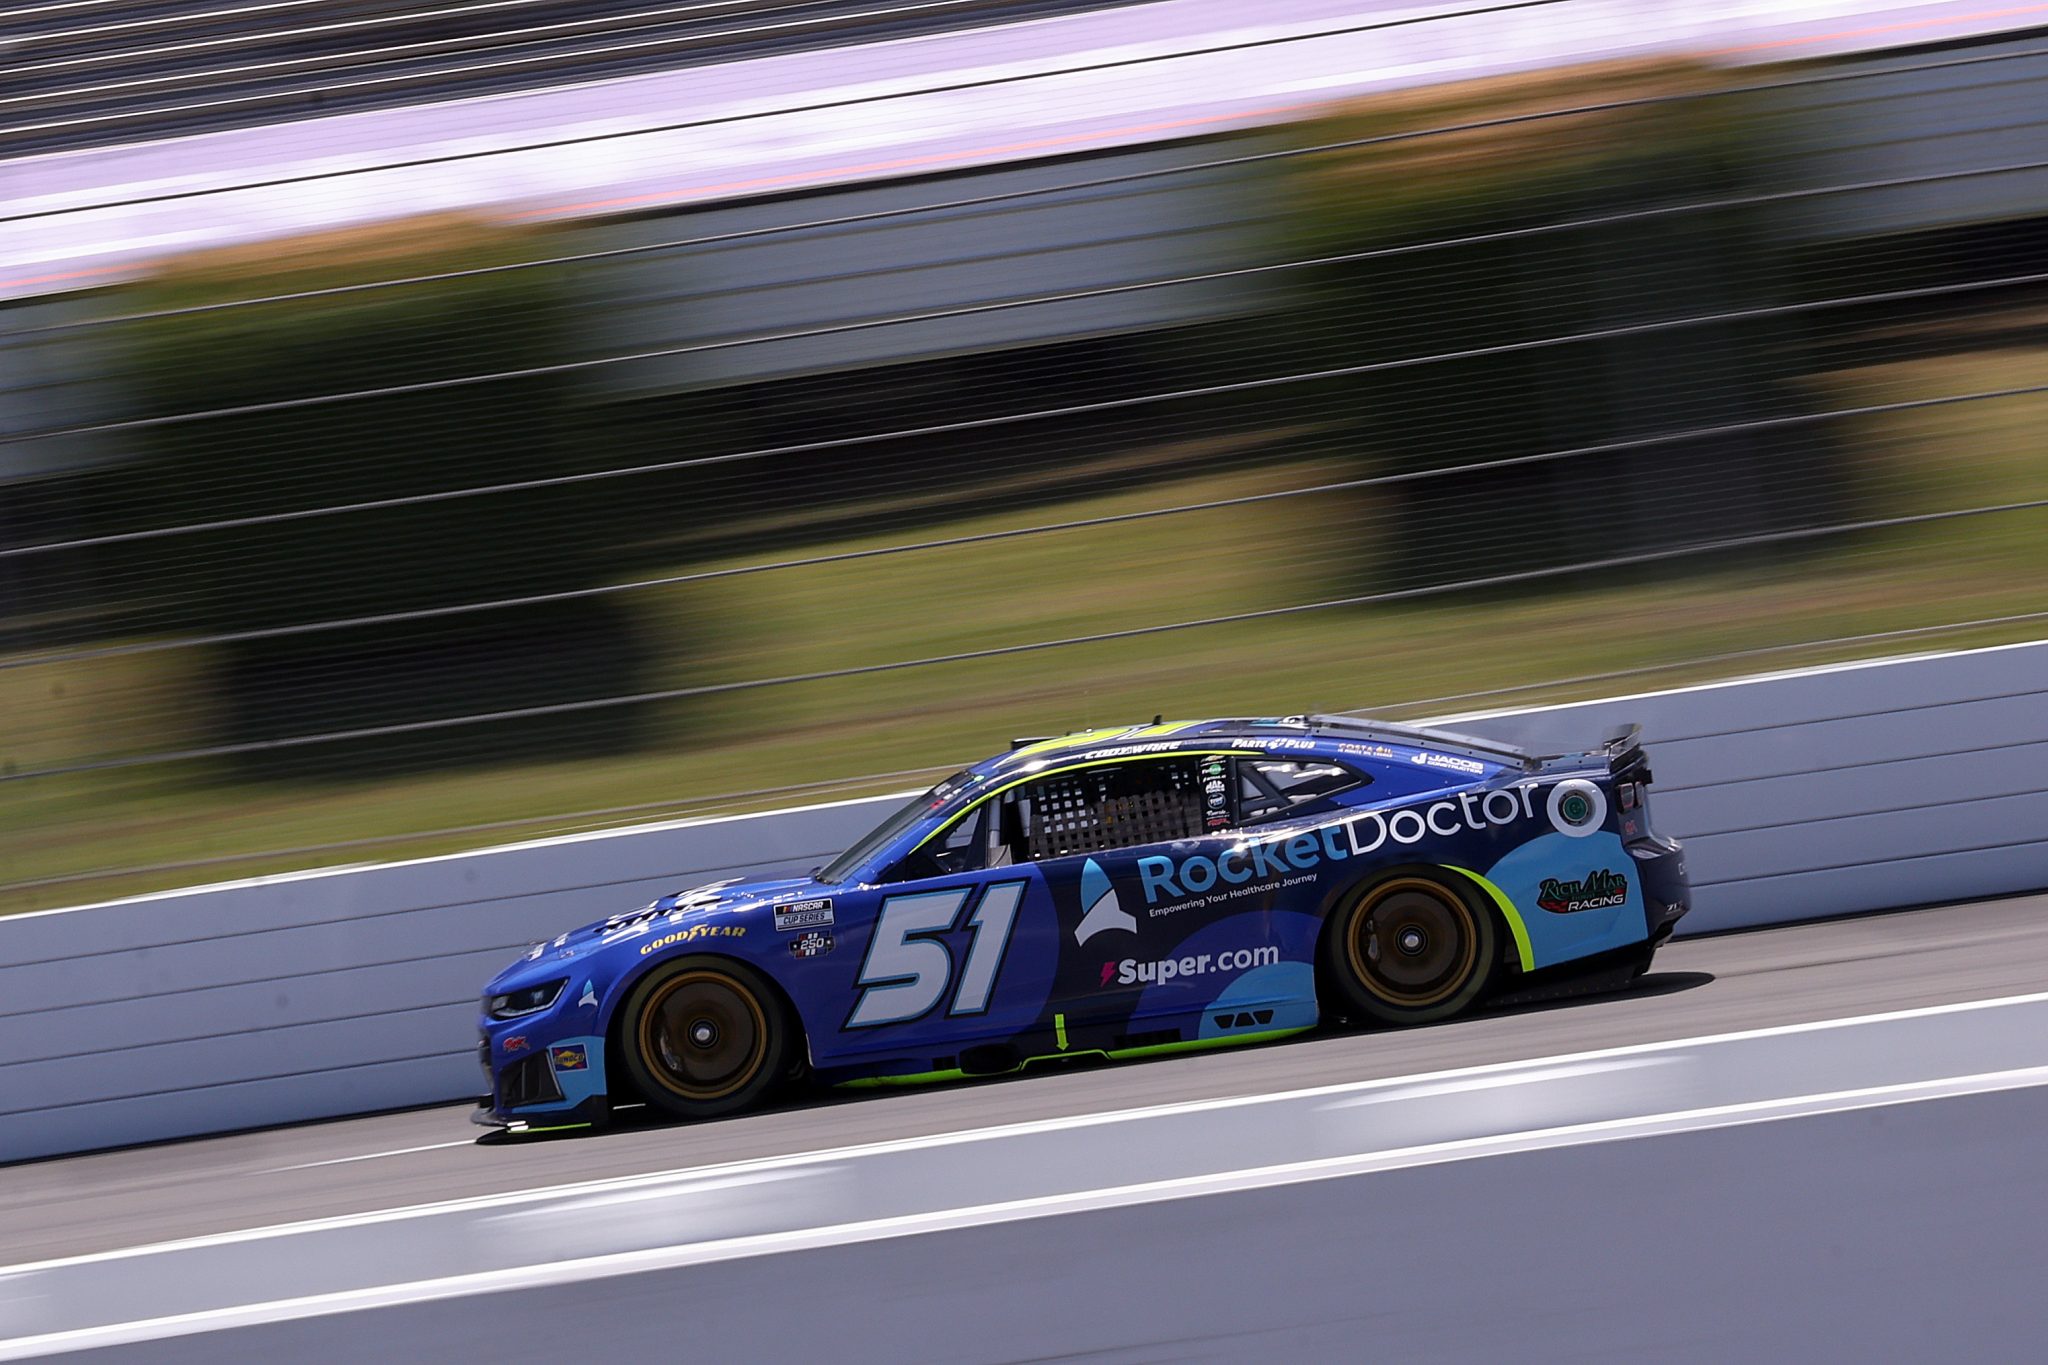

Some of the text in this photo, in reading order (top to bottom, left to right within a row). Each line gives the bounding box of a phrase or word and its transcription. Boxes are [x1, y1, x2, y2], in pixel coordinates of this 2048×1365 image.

[1231, 738, 1317, 749] PARTS PLUS
[1149, 872, 1318, 918] Empowering Your Healthcare Journey
[1567, 894, 1625, 912] RACING
[792, 901, 824, 912] NASCAR
[783, 912, 826, 925] CUP SERIES
[639, 924, 747, 956] GOODYEAR
[800, 937, 825, 950] 250
[841, 879, 1029, 1030] 51
[1117, 945, 1279, 986] Super.com
